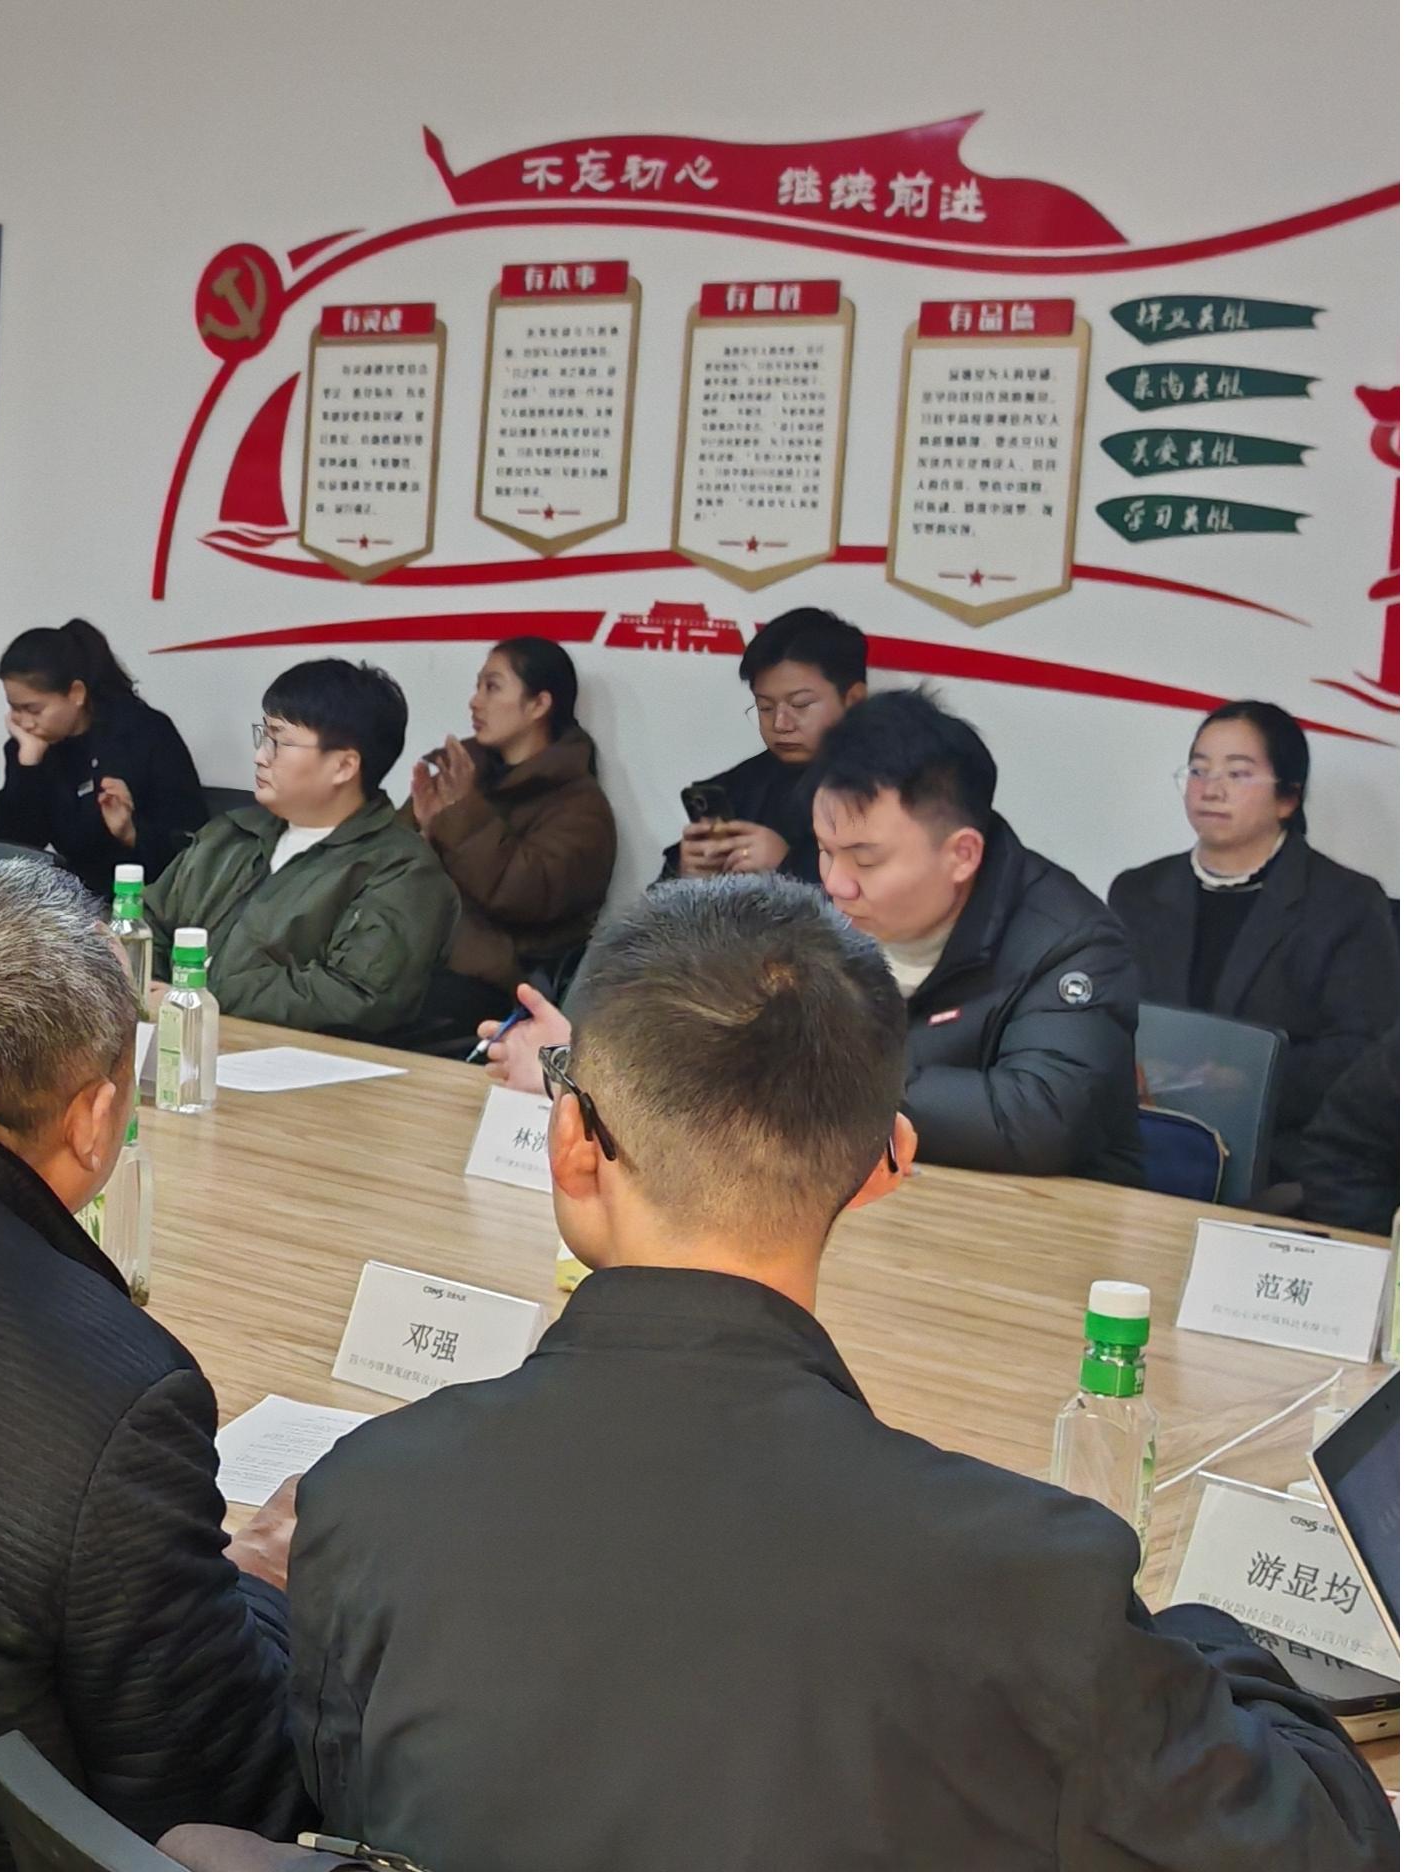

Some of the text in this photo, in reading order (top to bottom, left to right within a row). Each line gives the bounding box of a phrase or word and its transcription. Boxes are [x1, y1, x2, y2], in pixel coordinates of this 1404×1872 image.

[521, 148, 988, 223] 不忘初心 继续前进
[524, 265, 596, 291] 有本事
[342, 308, 403, 332] 有灵魂
[950, 303, 1035, 332] 有品德
[1136, 300, 1249, 332] 捍卫英雄
[1132, 434, 1239, 467] 关爱英雄
[1124, 500, 1234, 533] 学习英雄
[1256, 1273, 1313, 1307] 范菊
[402, 1322, 459, 1363] 邓强
[1247, 1550, 1362, 1614] 游显均
